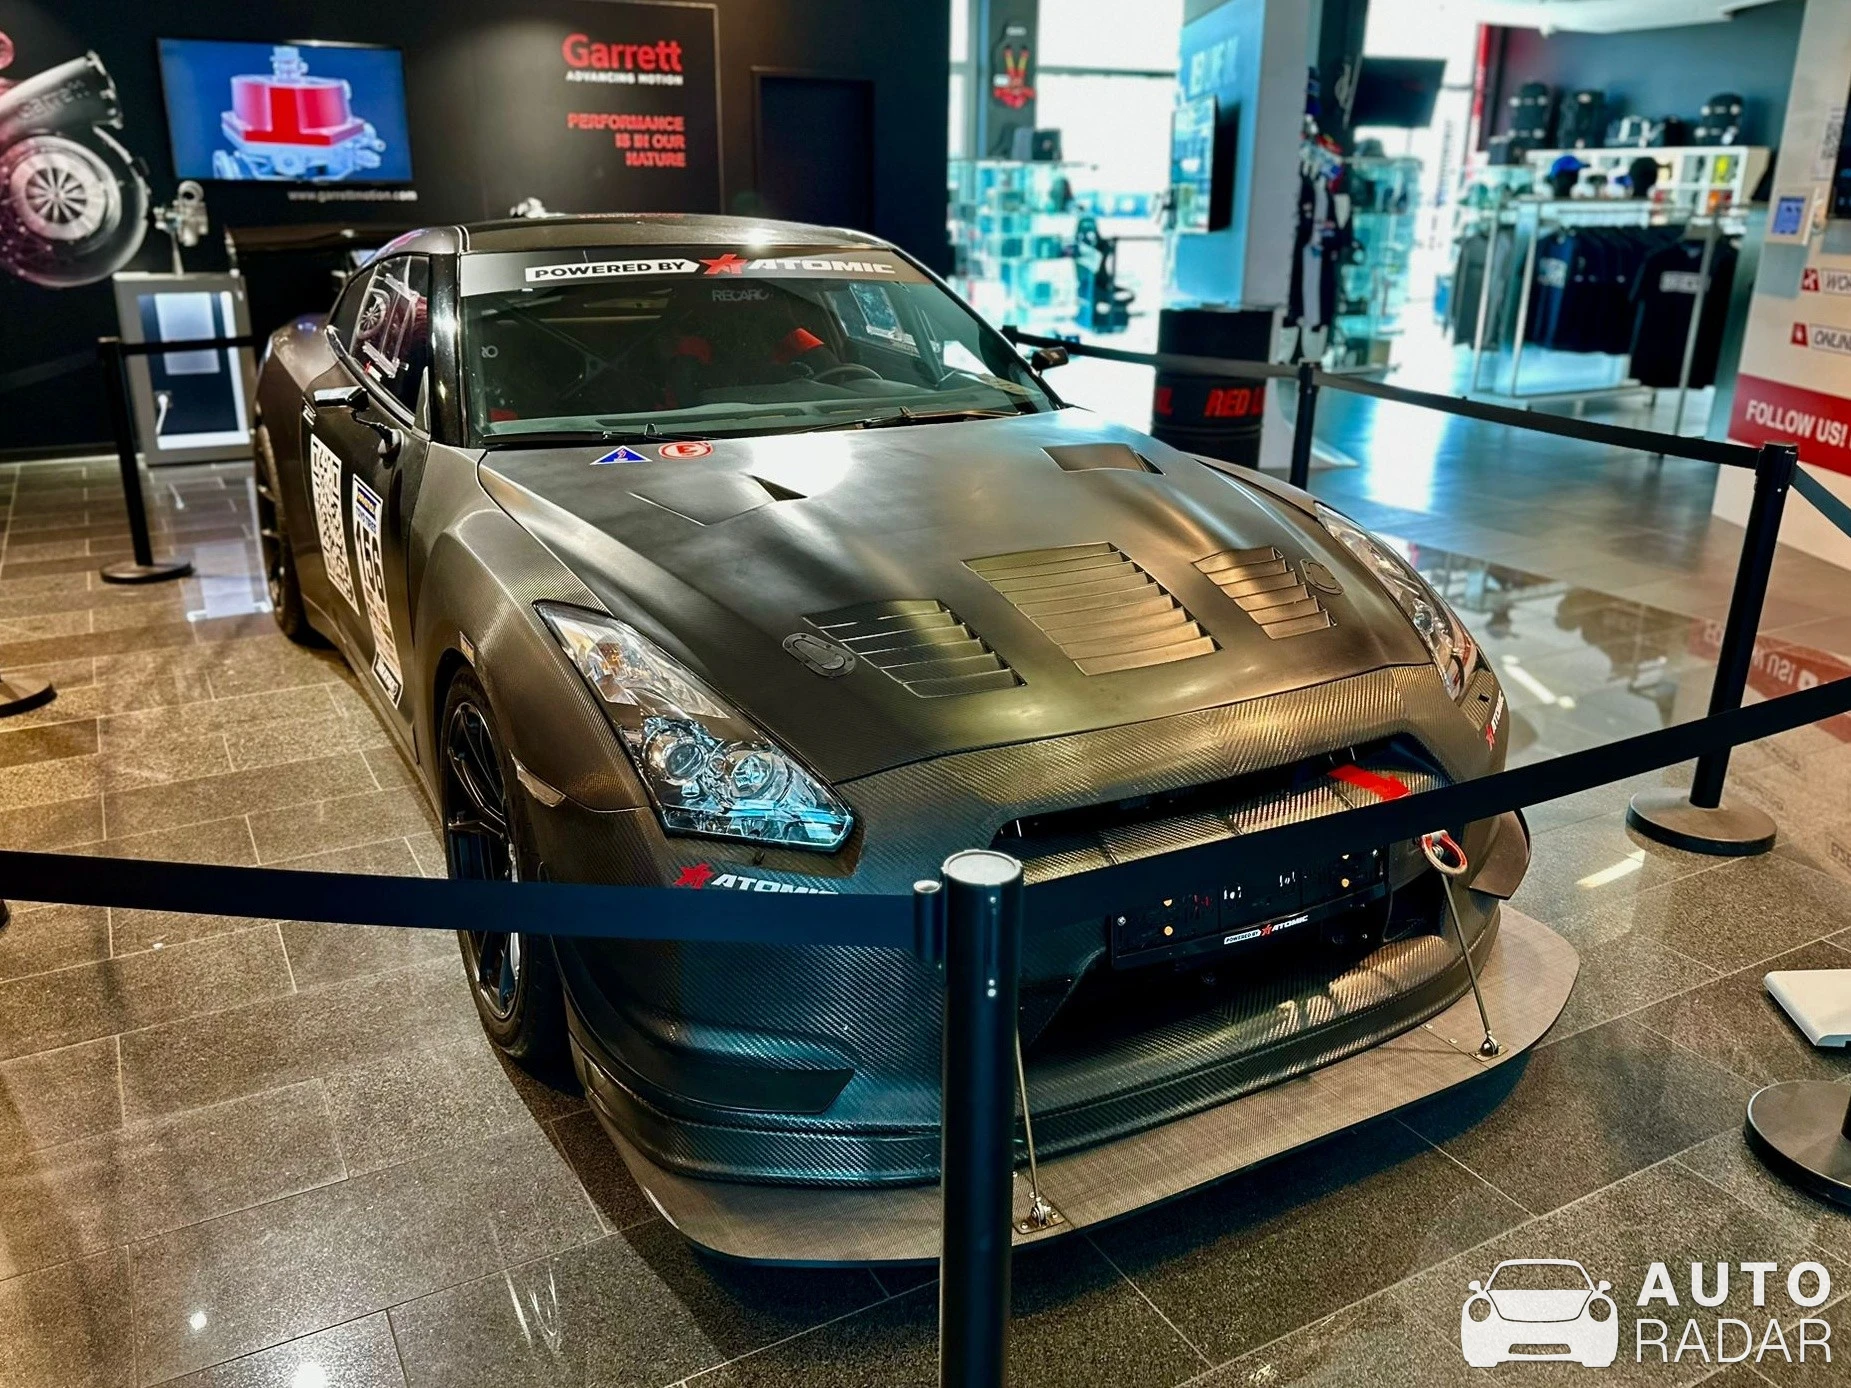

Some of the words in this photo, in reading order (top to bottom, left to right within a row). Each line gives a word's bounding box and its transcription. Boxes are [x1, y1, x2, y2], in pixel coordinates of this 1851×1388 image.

[562, 32, 683, 72] Garrett
[567, 112, 685, 131] PERFORMANCE
[615, 132, 631, 148] IS
[633, 133, 650, 148] IN
[651, 133, 685, 149] OUR
[625, 151, 686, 167] NATURE
[534, 262, 652, 279] POWERED
[658, 261, 686, 271] BY
[748, 259, 896, 274] ATOMIC
[1204, 388, 1251, 417] RED
[1745, 399, 1815, 439] FOLLOW
[1816, 417, 1849, 449] US!
[356, 520, 386, 603] 156
[1272, 915, 1309, 931] ATOMIC
